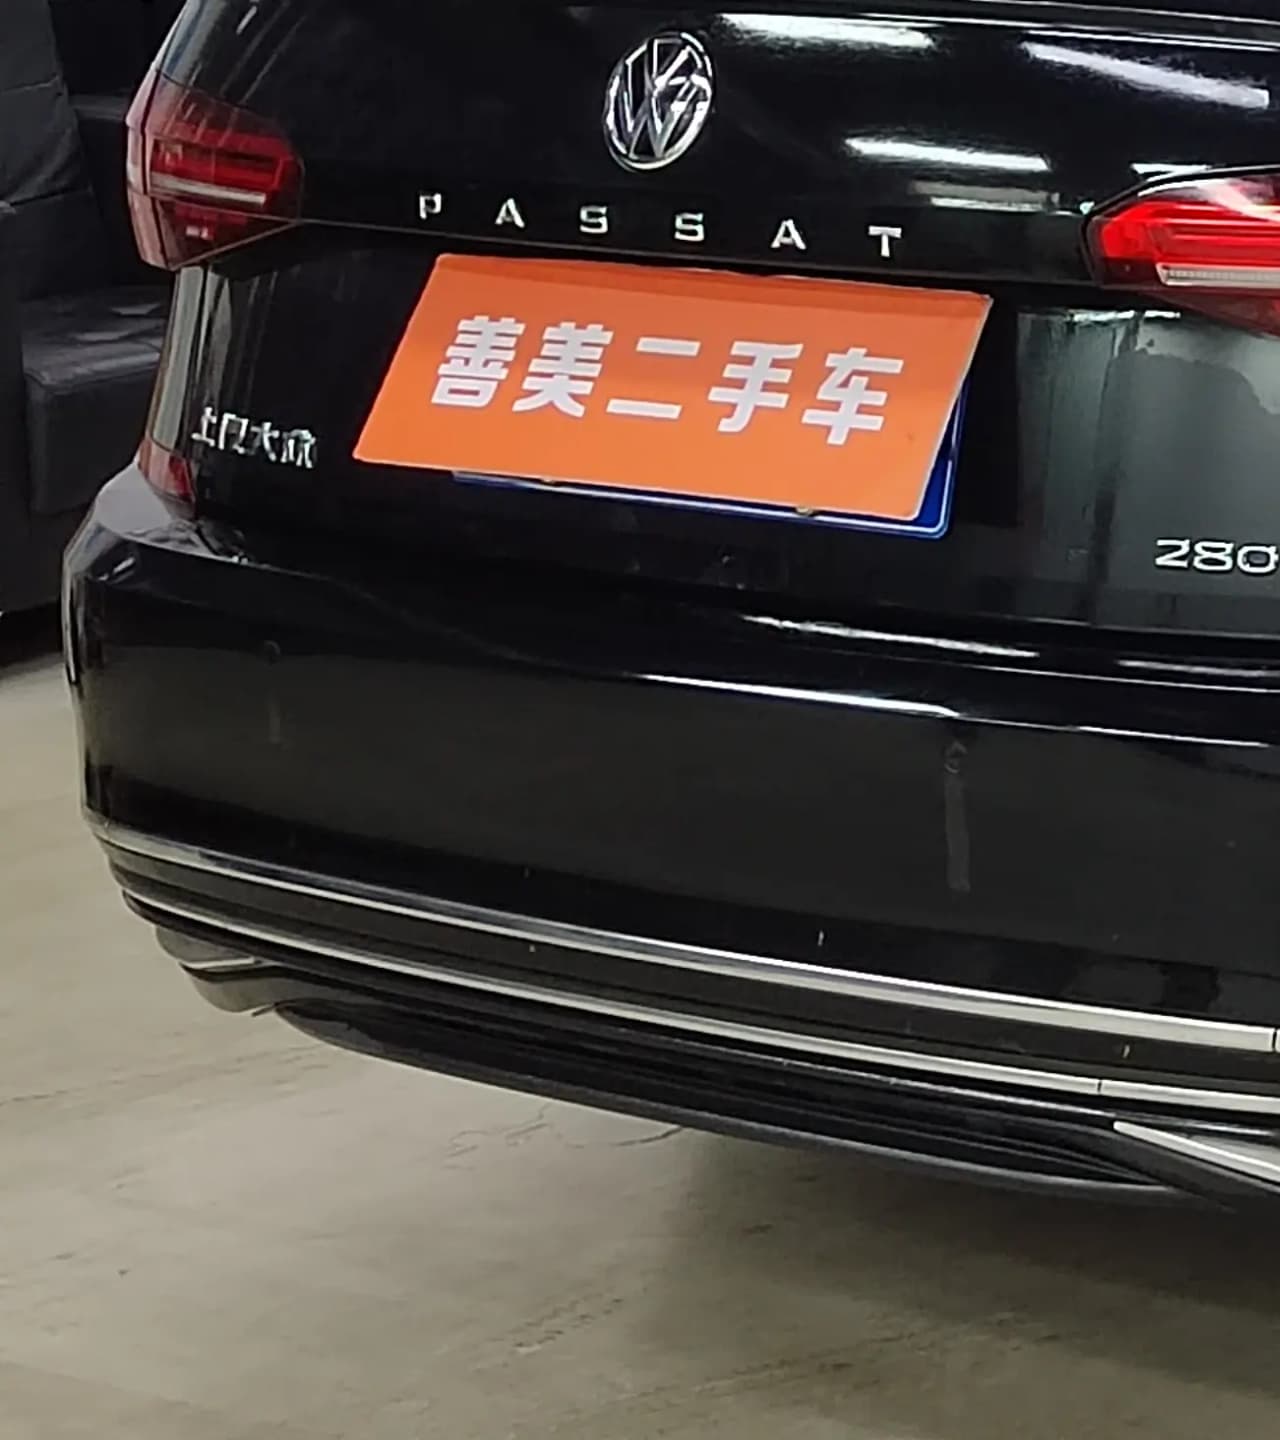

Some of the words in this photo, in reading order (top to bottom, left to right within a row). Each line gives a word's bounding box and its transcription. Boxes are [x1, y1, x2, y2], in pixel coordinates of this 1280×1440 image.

[418, 191, 902, 258] PASSAT
[431, 314, 905, 446] 善美二手车
[1154, 537, 1280, 578] 280
